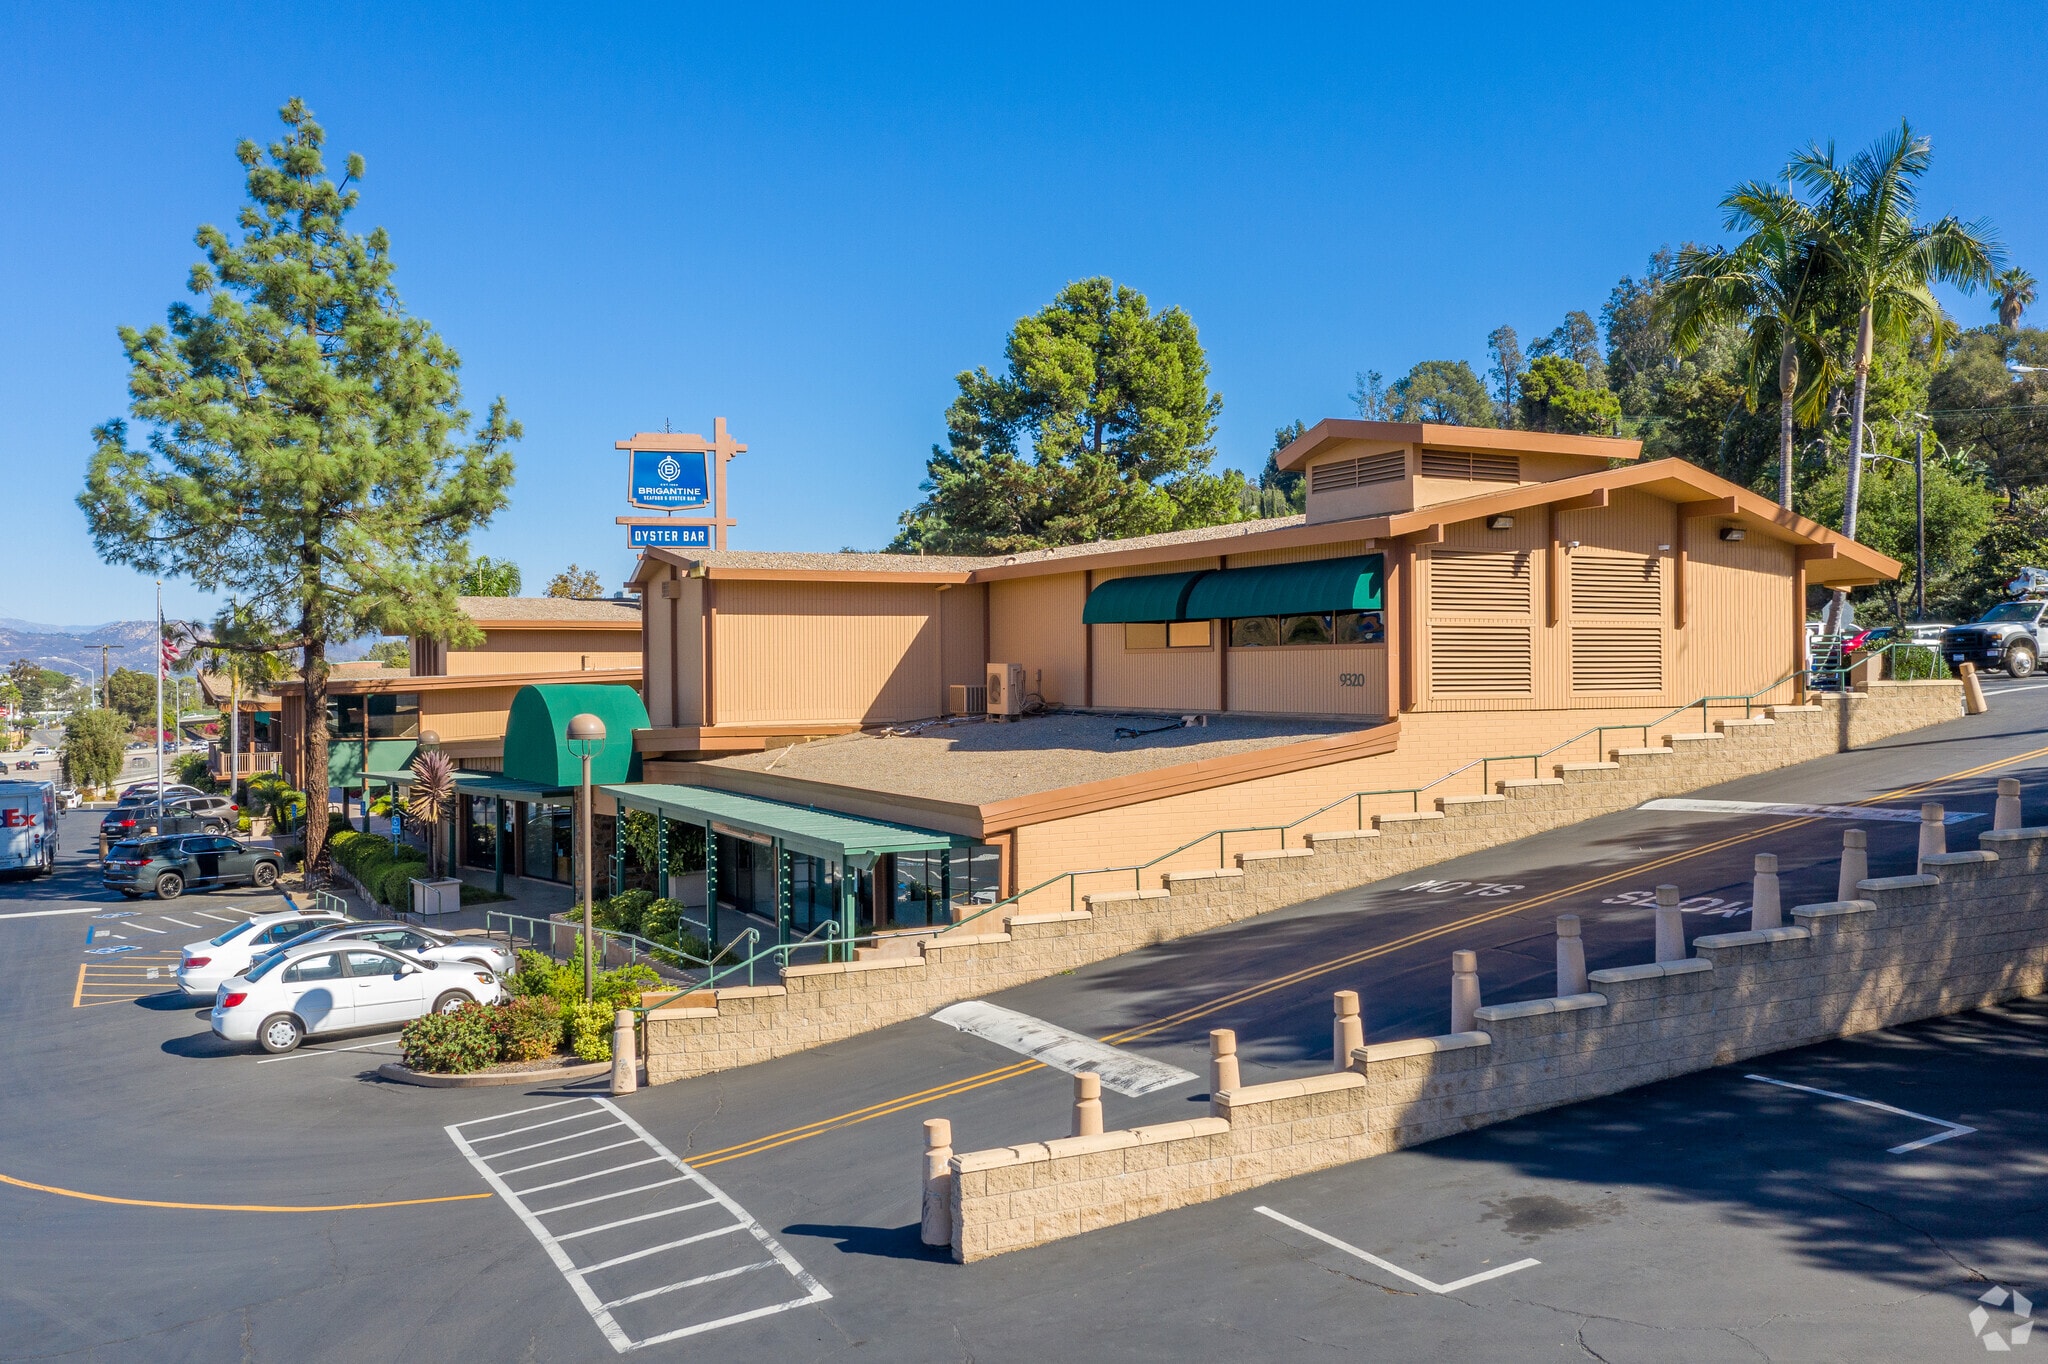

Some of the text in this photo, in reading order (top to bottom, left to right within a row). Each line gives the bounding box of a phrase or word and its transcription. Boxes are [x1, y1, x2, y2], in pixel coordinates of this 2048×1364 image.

[664, 465, 674, 474] B
[638, 487, 701, 495] BRIGANTINE
[635, 530, 704, 542] OYSTER BAR
[1339, 673, 1365, 687] 9320
[1398, 879, 1525, 897] SLOW
